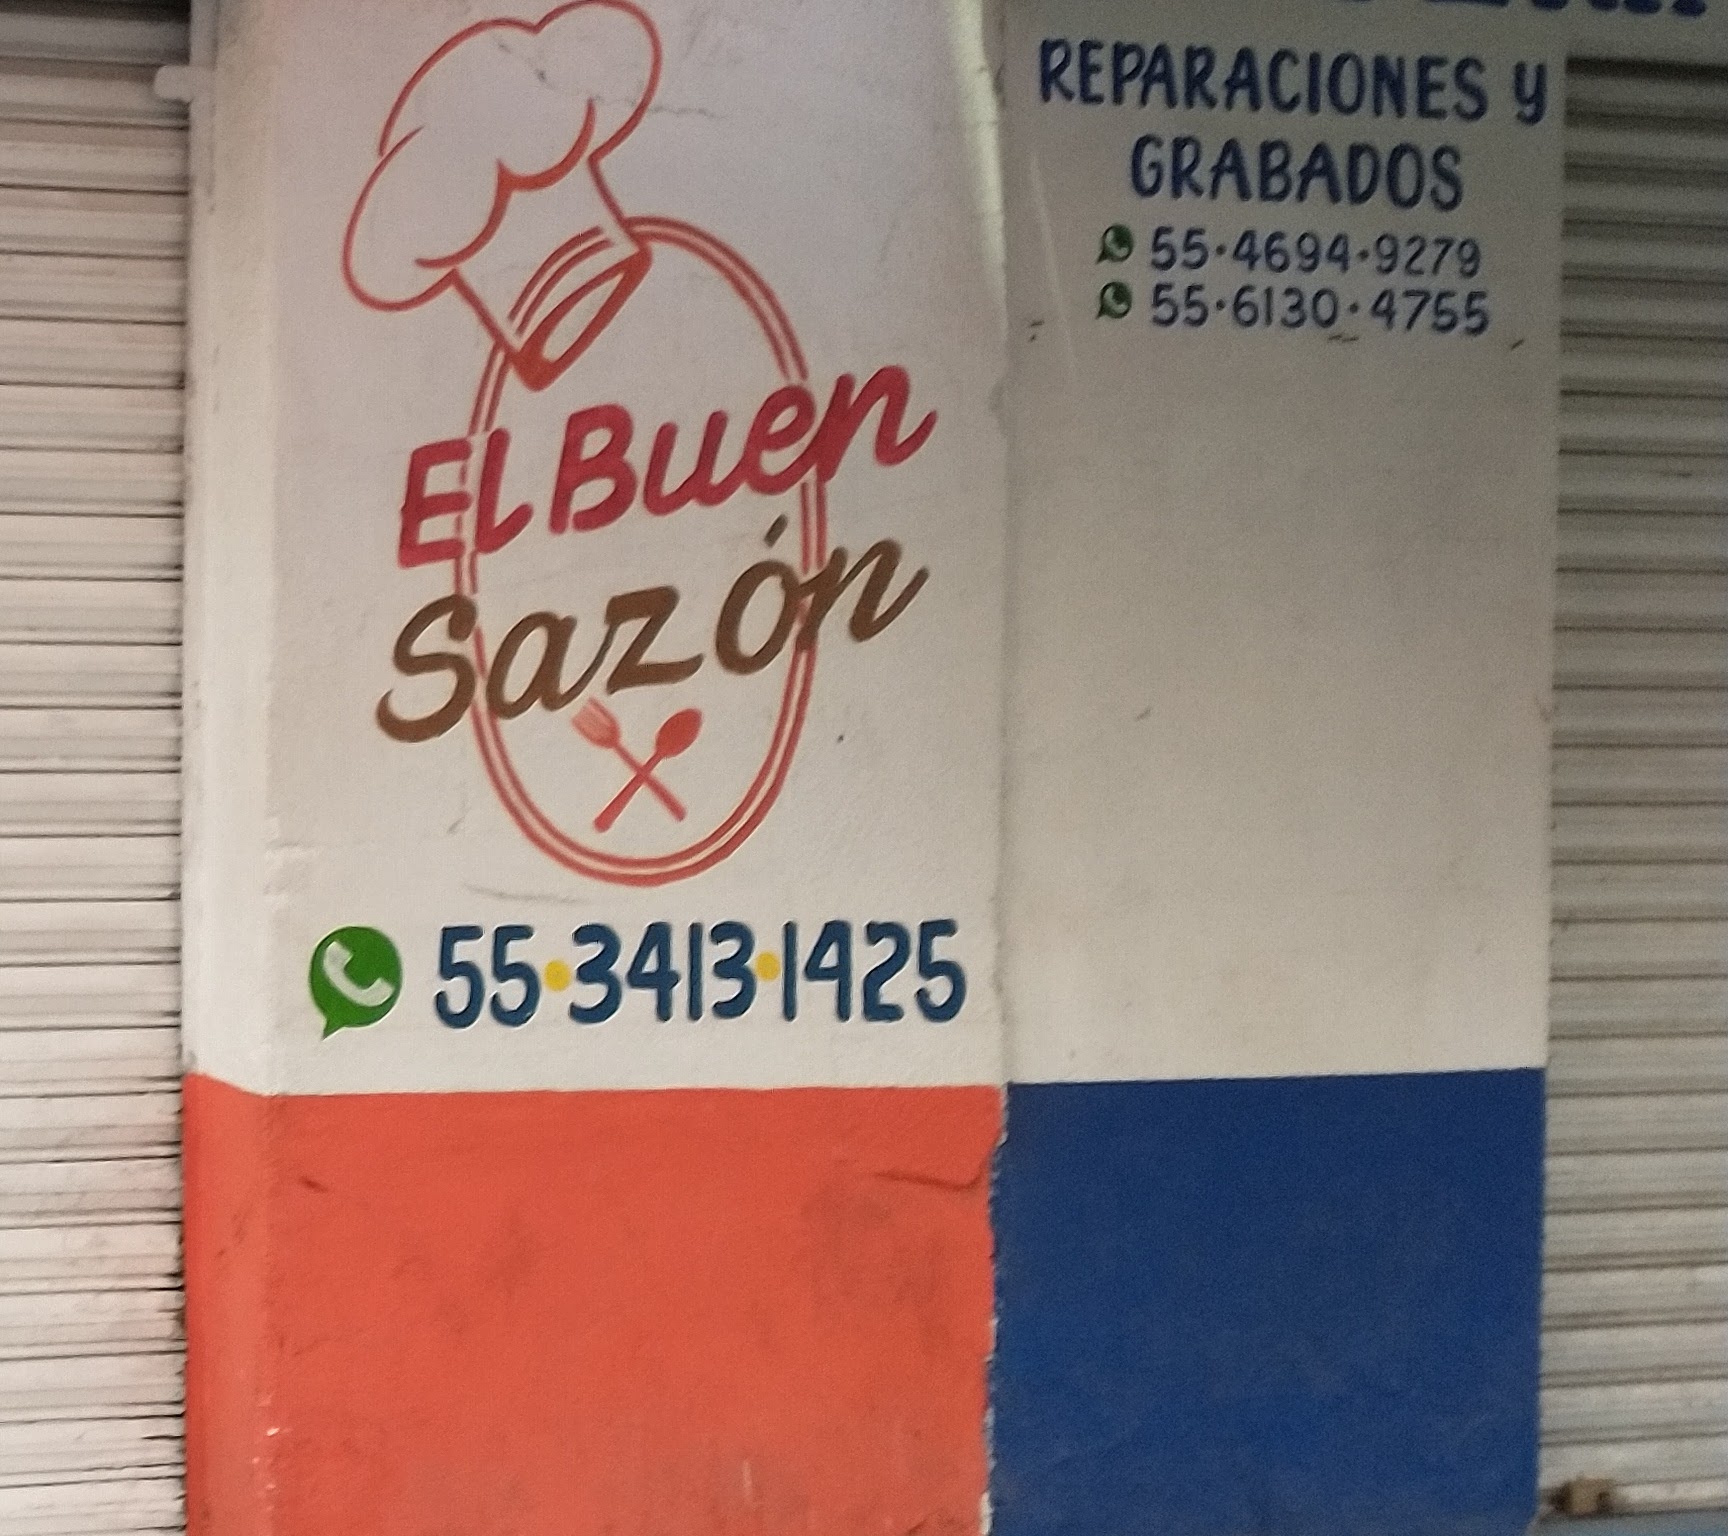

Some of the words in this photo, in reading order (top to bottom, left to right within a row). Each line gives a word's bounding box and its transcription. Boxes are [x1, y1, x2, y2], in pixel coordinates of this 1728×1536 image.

[1039, 37, 1490, 122] REPARACIONES
[1130, 133, 1465, 213] GRABADOS
[546, 364, 940, 534] Buen
[374, 514, 932, 746] Sazón
